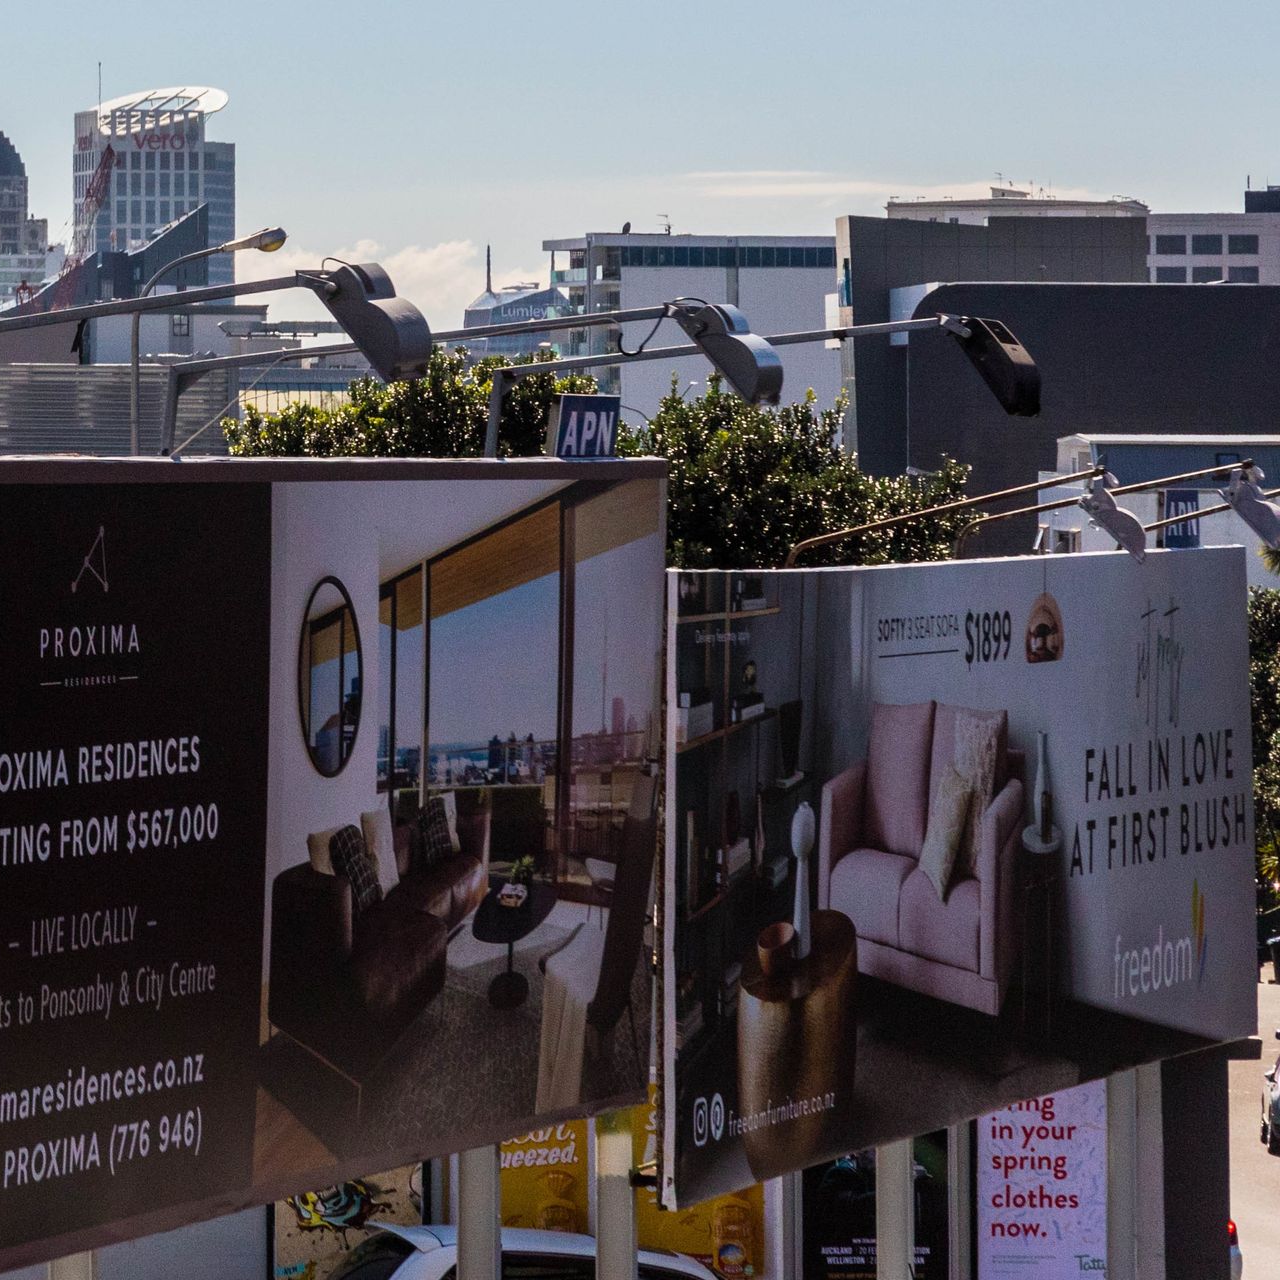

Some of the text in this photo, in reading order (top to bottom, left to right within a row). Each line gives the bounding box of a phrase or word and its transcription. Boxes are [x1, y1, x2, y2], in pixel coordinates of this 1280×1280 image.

[133, 132, 185, 150] vero
[501, 306, 547, 319] Lumley
[561, 411, 614, 455] APN
[1168, 501, 1197, 536] APN
[40, 624, 140, 658] PROXIMA
[878, 618, 906, 642] SOFTY
[915, 615, 934, 639] SEAT
[936, 614, 959, 638] SOFA
[965, 608, 1011, 672] $1899
[64, 675, 117, 687] RESIDENCES
[78, 735, 200, 784] RESIDENCES
[1085, 729, 1233, 803] FALL IN LOVE
[60, 815, 118, 859] FROM
[127, 802, 219, 854] $567,000
[1069, 793, 1247, 878] AT FIRST BLUSH
[31, 905, 137, 957] LIVE LOCALLY
[1113, 924, 1193, 1000] freedom
[18, 992, 34, 1025] to
[41, 973, 114, 1020] Ponsonby
[119, 970, 130, 1006] &
[136, 965, 164, 1010] City
[170, 962, 216, 997] Centre
[729, 1092, 836, 1136] freedomfurniture.co.nz
[1007, 1097, 1056, 1121] ing
[3, 1132, 101, 1188] PROXIMA
[109, 1120, 151, 1176] (776
[159, 1106, 202, 1156] 946)
[991, 1116, 1077, 1149] in your
[500, 1140, 578, 1169] ueezed.
[991, 1147, 1067, 1179] spring
[991, 1186, 1079, 1209] clothes
[991, 1220, 1047, 1238] now.
[821, 1246, 853, 1255] AUCKLAND
[826, 1256, 866, 1265] WELLINGTON
